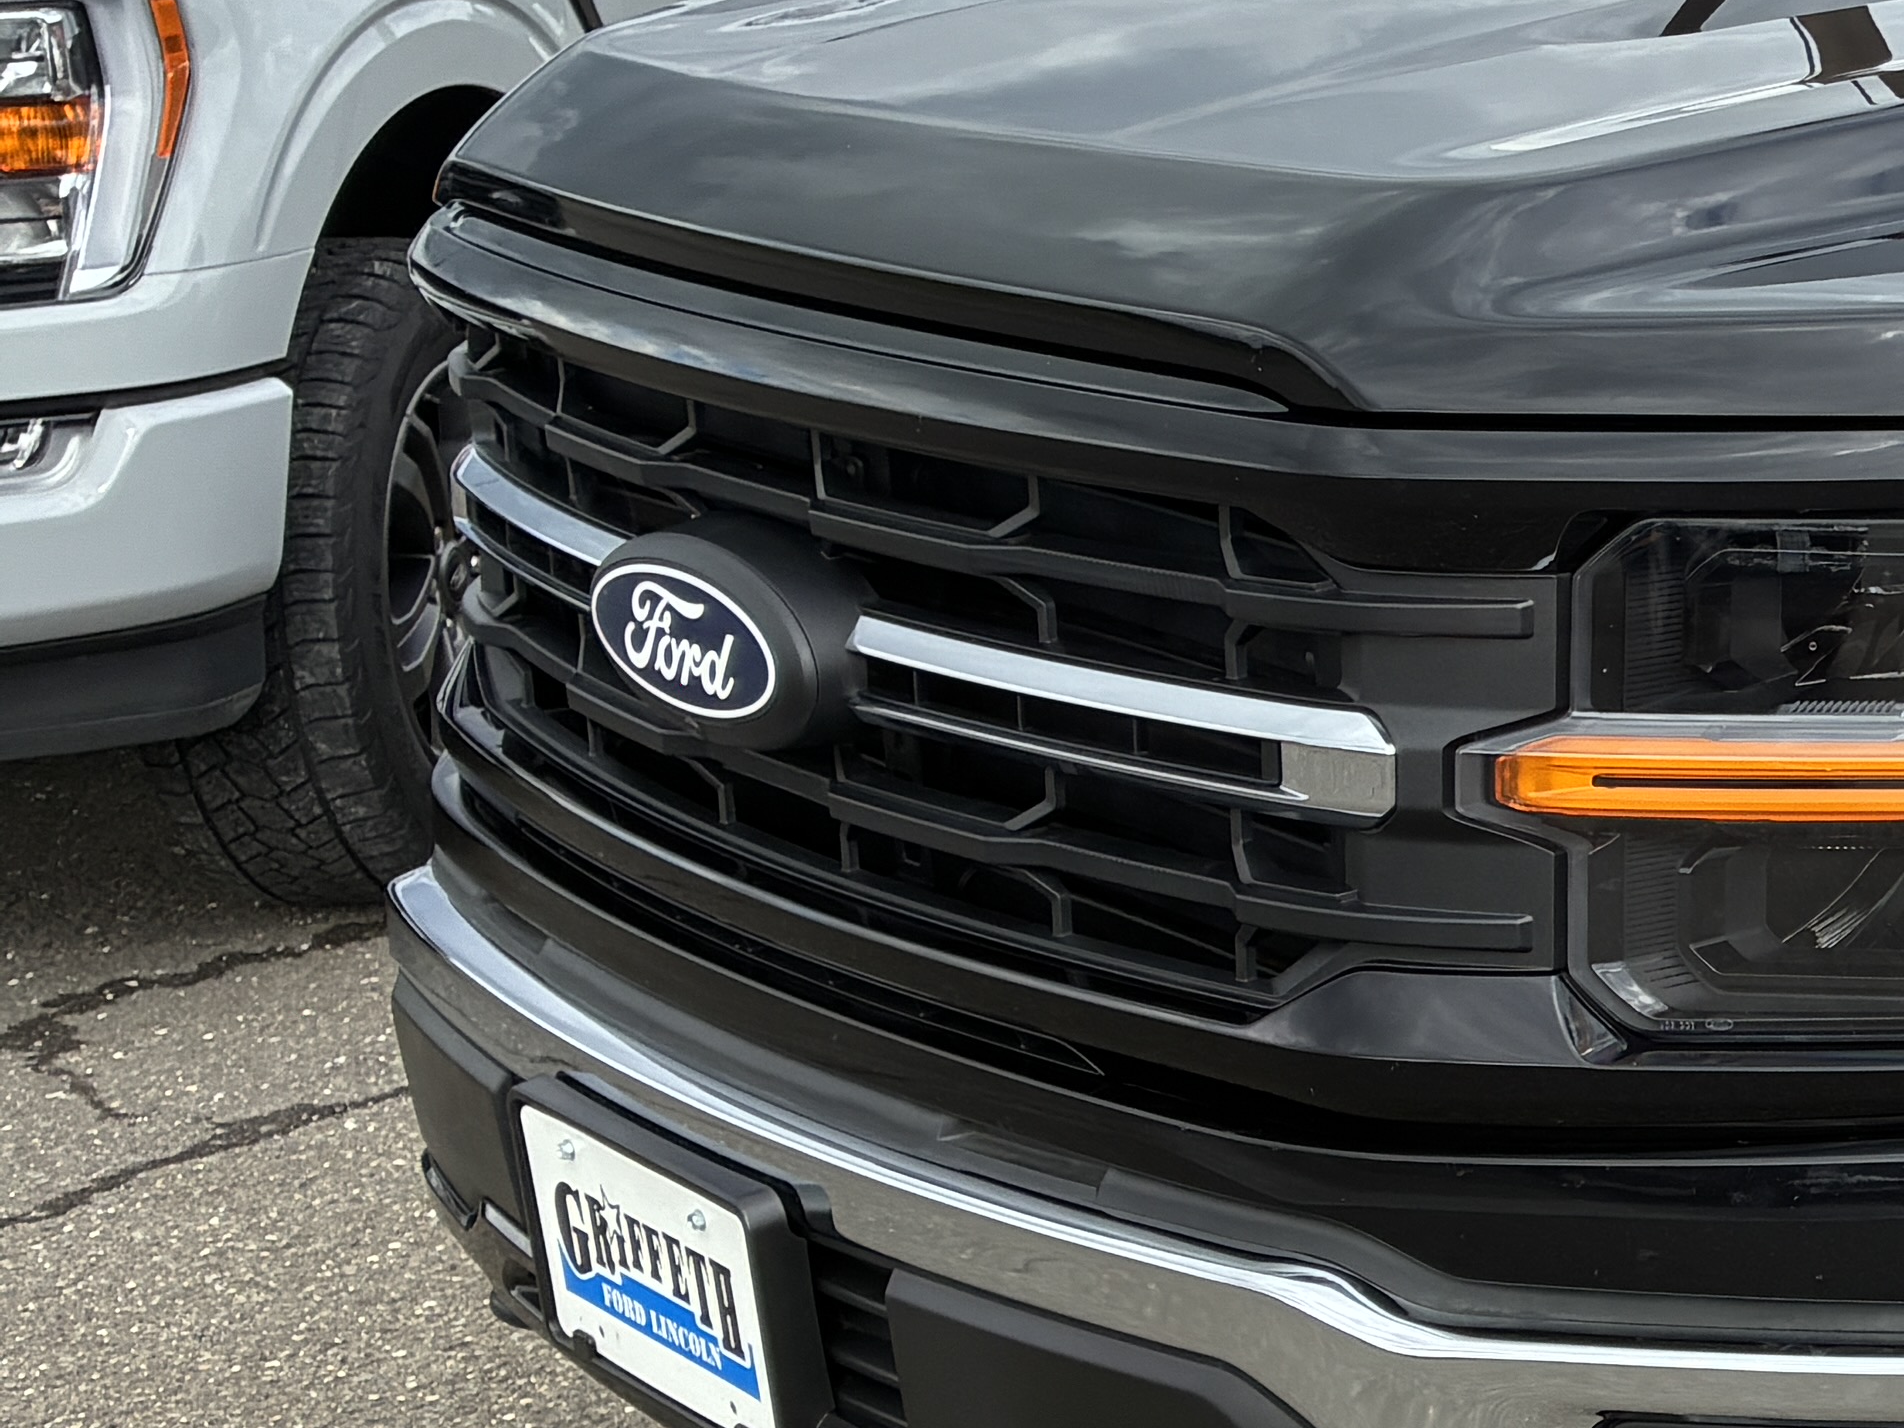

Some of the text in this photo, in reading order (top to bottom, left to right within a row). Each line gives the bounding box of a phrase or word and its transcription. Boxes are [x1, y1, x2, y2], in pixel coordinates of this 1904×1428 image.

[624, 580, 735, 700] Ford
[554, 1181, 745, 1360] GRIFFETH
[601, 1282, 723, 1371] FORD LINCOLN
